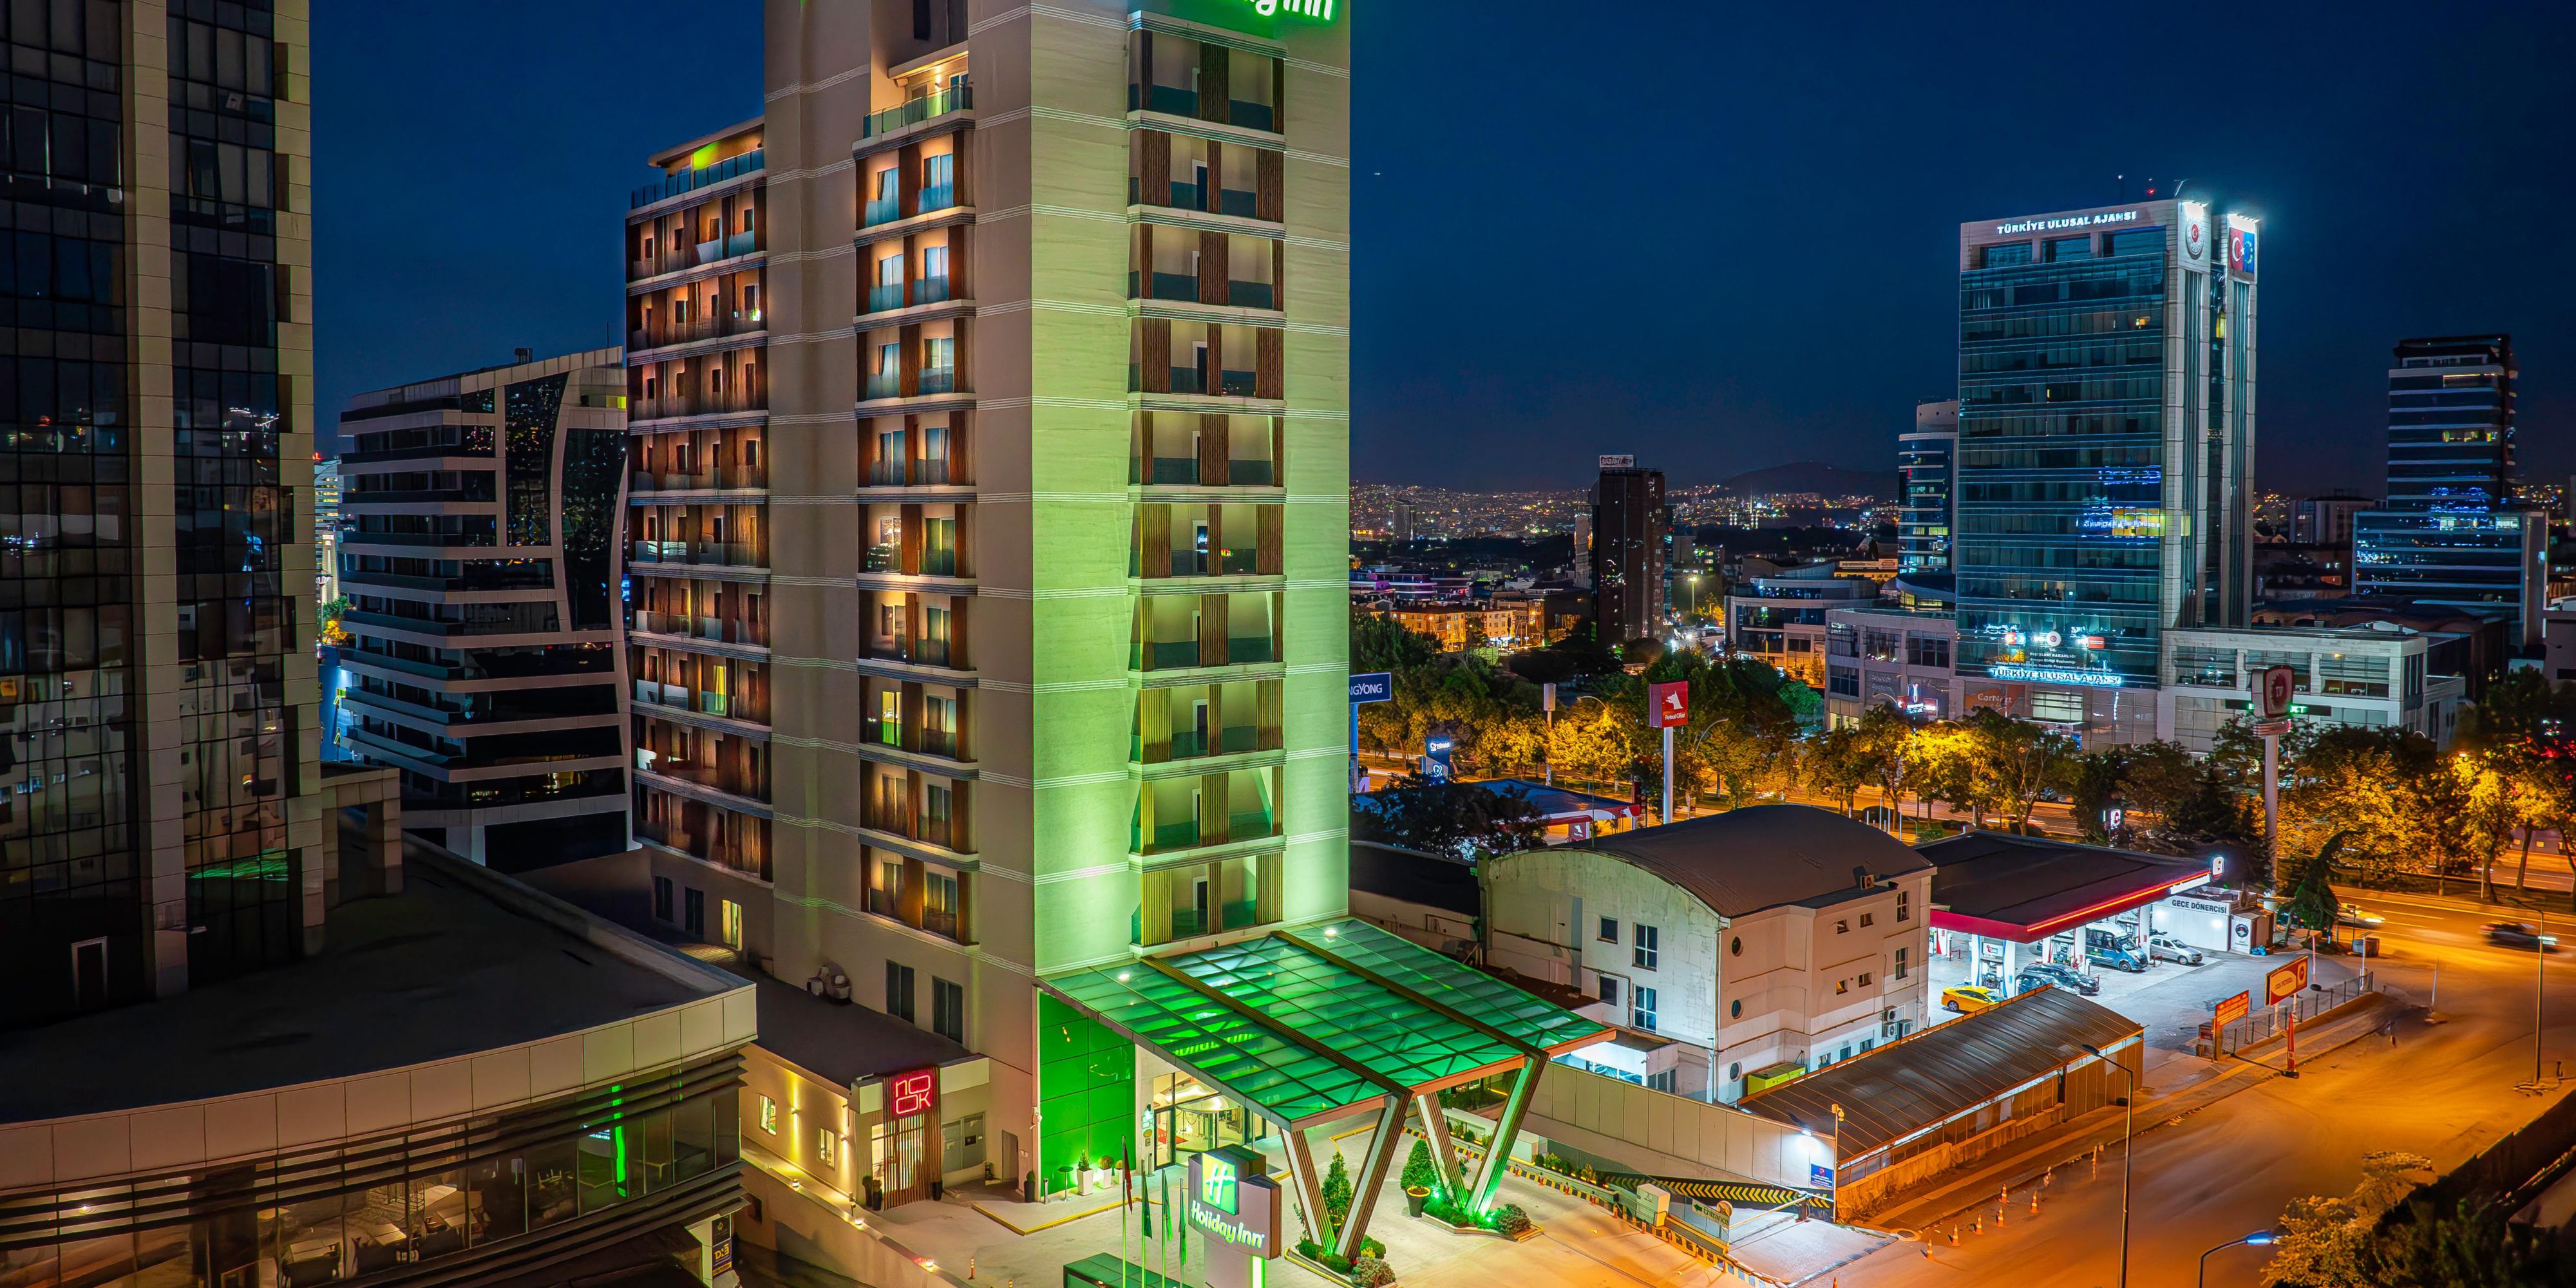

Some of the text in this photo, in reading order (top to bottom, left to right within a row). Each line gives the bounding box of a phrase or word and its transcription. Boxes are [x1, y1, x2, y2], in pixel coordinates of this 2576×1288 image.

[1997, 211, 2137, 234] TÜRKİYE ULUSAL AJANSI
[1993, 667, 2119, 684] TÜRKİYE ULUSAL AJANSI
[2172, 900, 2227, 914] GECE DÖNERCİSİ
[1191, 1199, 1263, 1249] Holiday Inn
